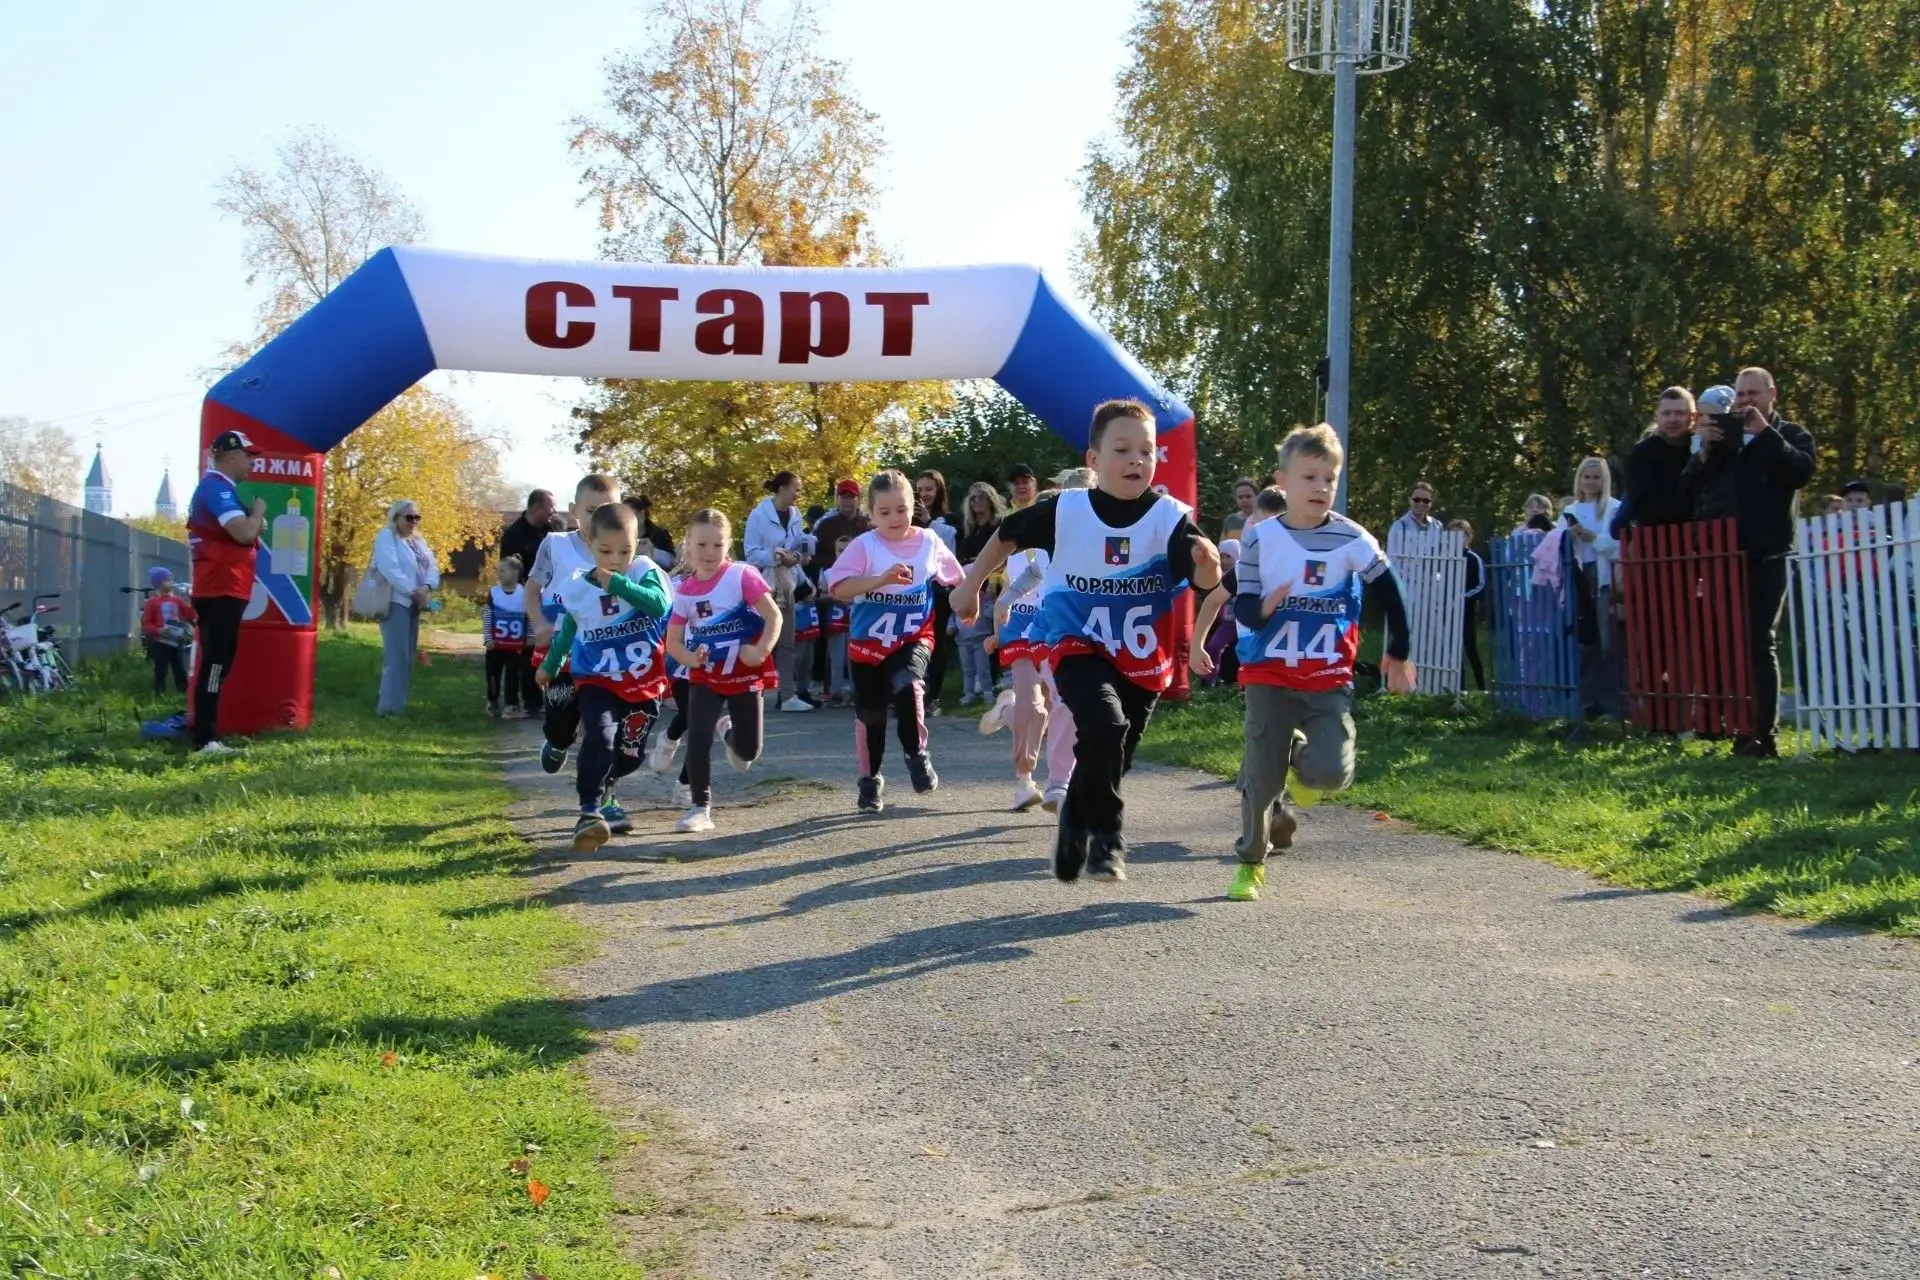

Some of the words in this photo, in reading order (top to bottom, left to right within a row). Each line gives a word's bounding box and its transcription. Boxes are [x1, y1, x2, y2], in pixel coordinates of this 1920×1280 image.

[865, 591, 927, 606] КОРЯЖМ
[1065, 574, 1166, 596] КОРЯЖМА
[1275, 595, 1346, 614] ОРЯЖМ
[495, 619, 522, 639] 59
[868, 612, 924, 648] 45
[1081, 604, 1158, 660] 46
[1264, 620, 1344, 668] 44
[592, 640, 653, 682] 48
